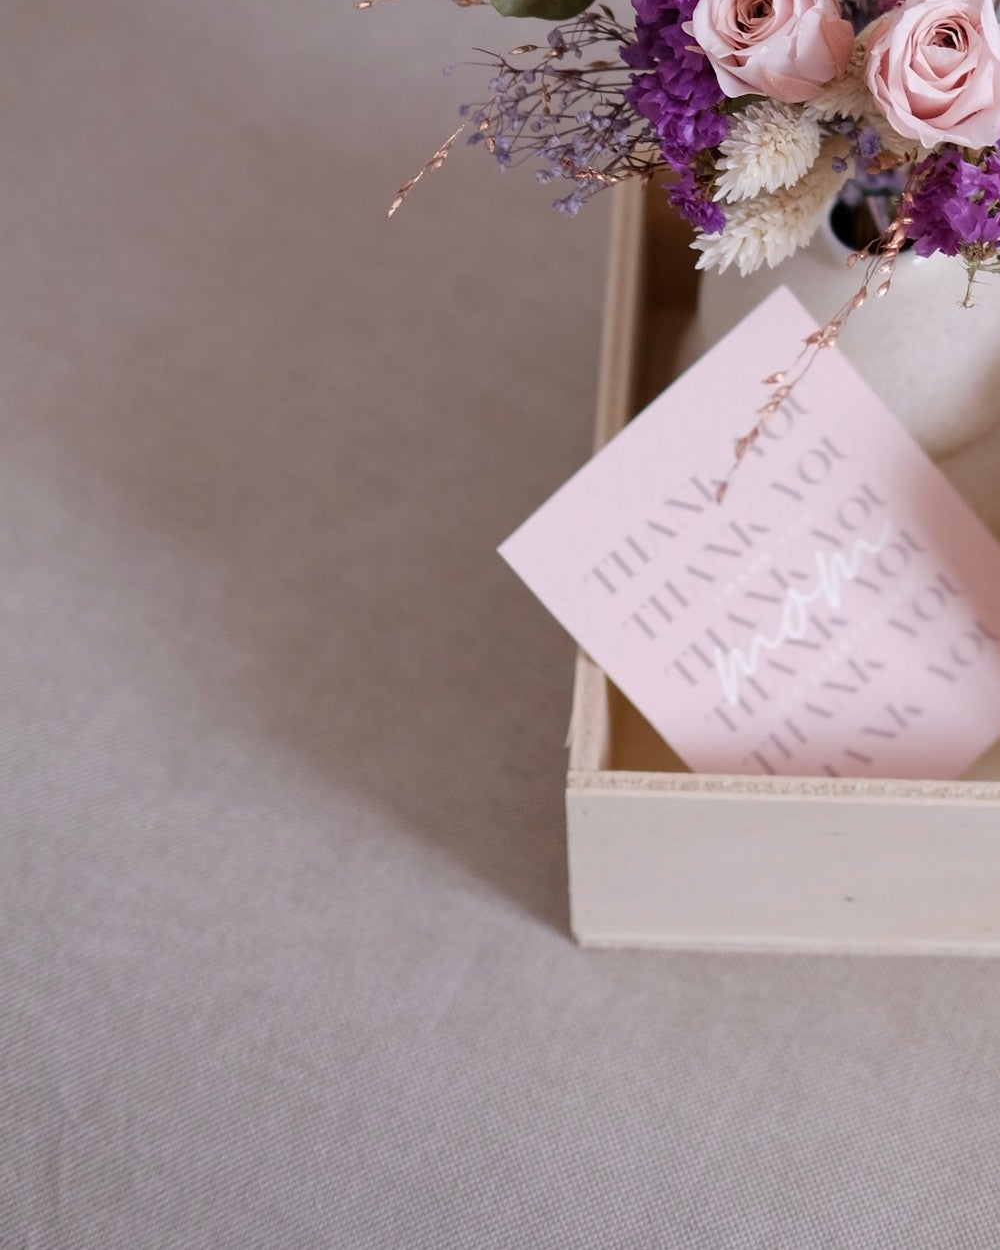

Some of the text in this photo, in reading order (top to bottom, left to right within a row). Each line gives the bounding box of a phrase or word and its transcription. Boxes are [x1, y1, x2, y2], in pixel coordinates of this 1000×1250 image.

[581, 473, 727, 595] THANK
[621, 435, 848, 640] THANK YOU
[662, 482, 886, 687] THANK YOU
[701, 612, 849, 733] THANK
[849, 529, 925, 595] YOU
[714, 518, 892, 705] mom
[739, 657, 886, 776] THANK
[887, 572, 964, 639] YOU
[822, 617, 1000, 777] ANK YOU
